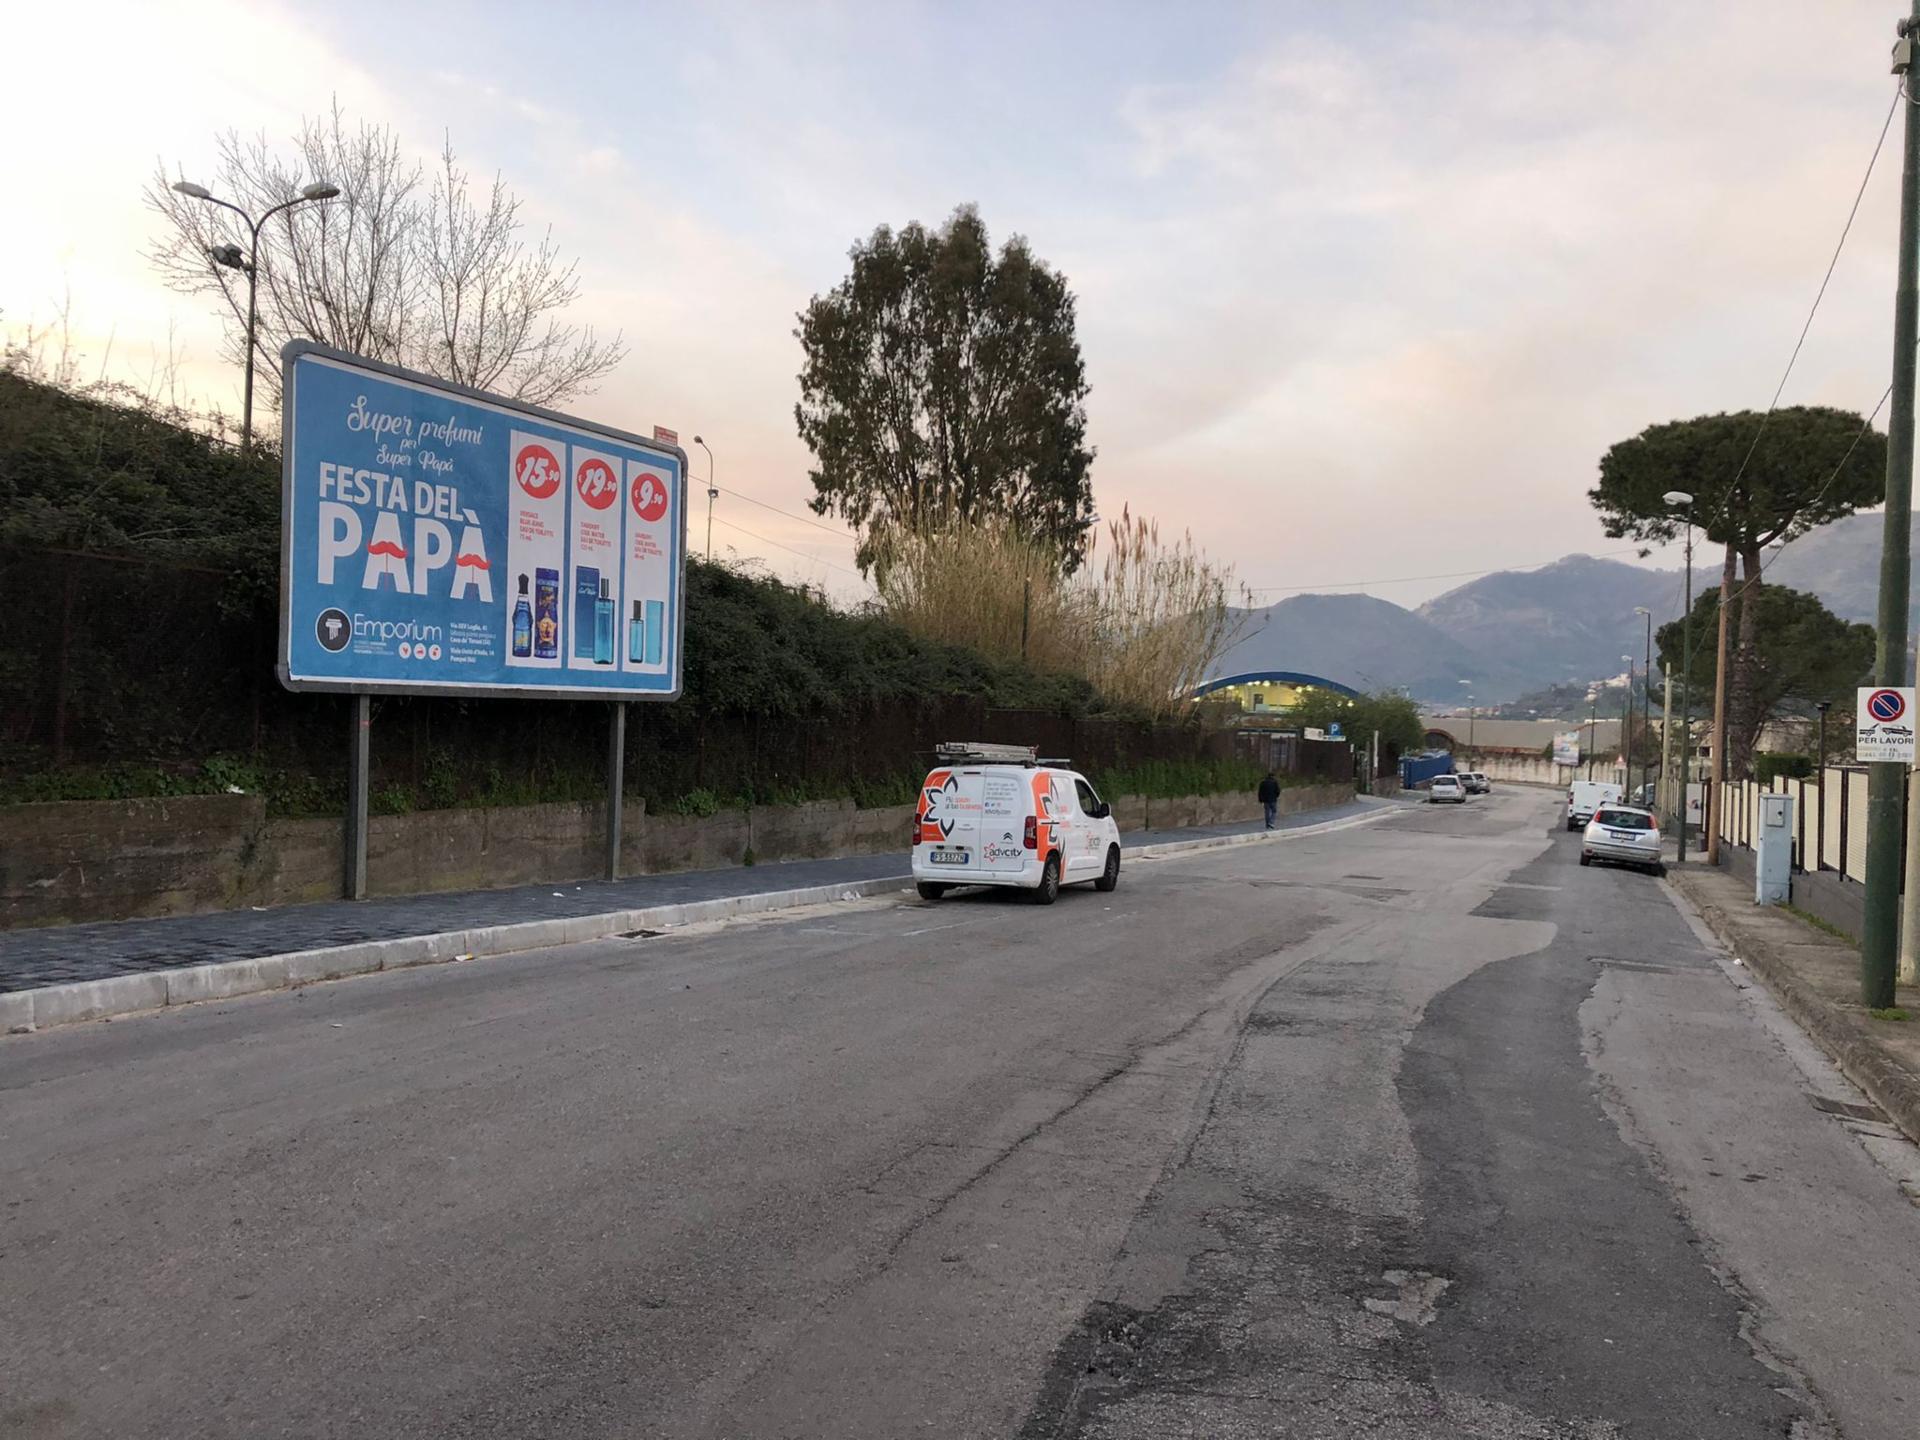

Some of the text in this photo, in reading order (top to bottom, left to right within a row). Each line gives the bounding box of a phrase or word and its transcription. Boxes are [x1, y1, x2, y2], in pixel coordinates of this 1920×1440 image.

[347, 395, 483, 448] Super profumi
[400, 438, 417, 453] per
[376, 444, 454, 476] Super Papà
[319, 461, 464, 522] FESTA DEL
[317, 501, 494, 603] PAPÀ
[354, 613, 443, 641] Emporium
[1331, 724, 1338, 734] P
[1880, 737, 1914, 745] LAVORI
[989, 847, 1022, 857] advcity
